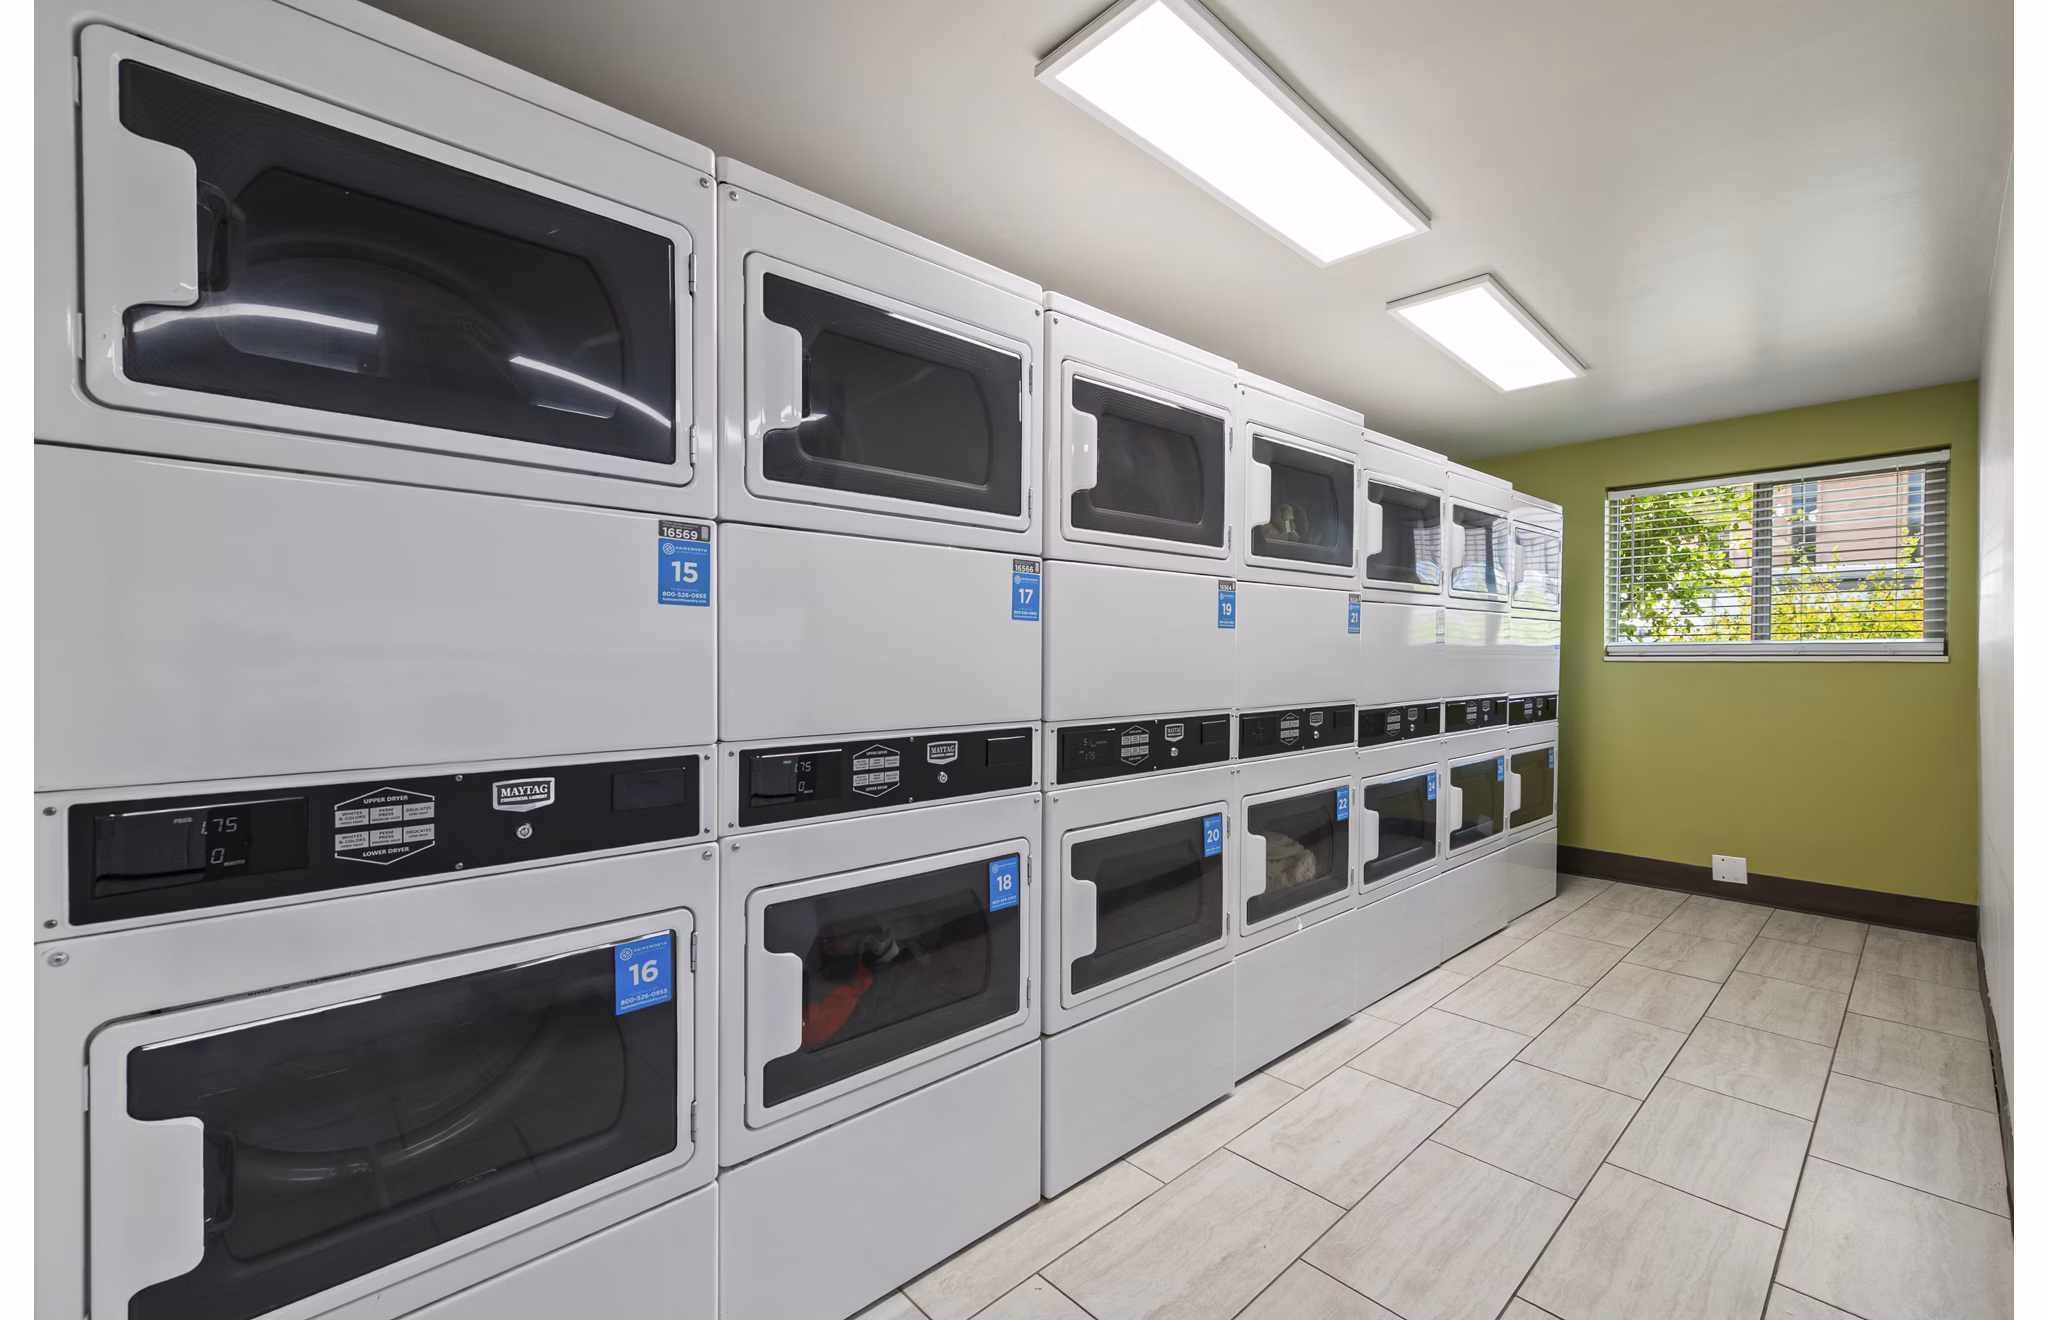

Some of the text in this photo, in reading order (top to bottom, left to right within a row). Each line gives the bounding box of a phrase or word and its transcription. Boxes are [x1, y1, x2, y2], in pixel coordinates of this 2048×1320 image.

[663, 527, 697, 539] 16569
[672, 561, 698, 583] 15
[662, 591, 706, 599] 800-526-0955
[1019, 588, 1033, 604] 17
[1222, 603, 1232, 616] 19
[1351, 612, 1358, 623] 21
[931, 745, 954, 753] MAYTAG
[501, 784, 548, 797] MAYTAG
[798, 781, 805, 792] 0
[1339, 798, 1347, 810] 22
[1208, 828, 1219, 843] 20
[210, 848, 225, 864] 0
[363, 849, 387, 857] LOWER
[997, 874, 1012, 892] 18
[629, 960, 659, 986] 16
[621, 988, 668, 1005] 800-526-0955
